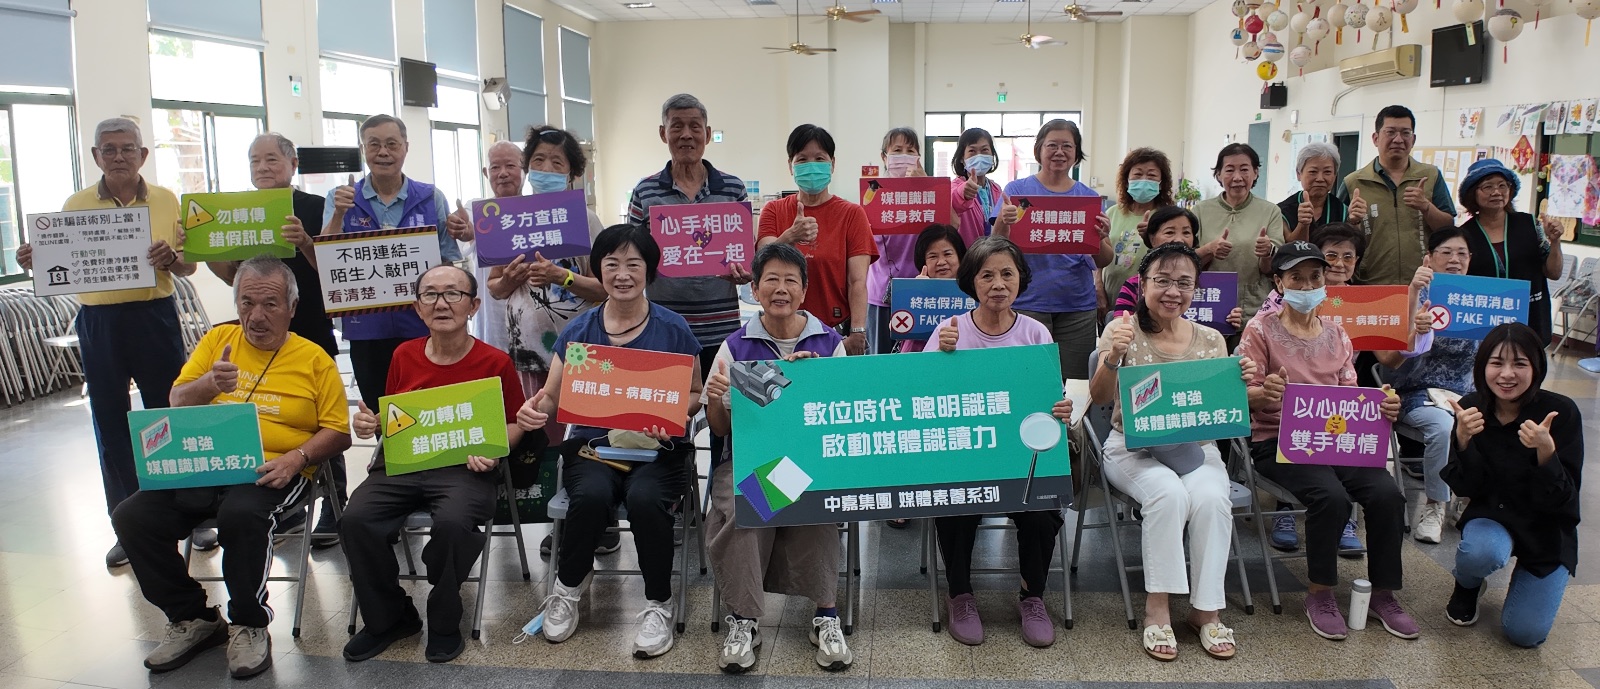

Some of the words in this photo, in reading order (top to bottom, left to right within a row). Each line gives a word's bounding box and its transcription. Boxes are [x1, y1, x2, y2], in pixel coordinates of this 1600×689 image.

[881, 190, 936, 205] 媒體識讀
[216, 207, 266, 225] 勿轉傳
[500, 208, 568, 230] 多方查證
[661, 213, 743, 235] 心手相映
[881, 209, 935, 223] 終身教育
[1030, 210, 1086, 225] 媒體識讀
[209, 229, 275, 248] 錯假訊息
[511, 229, 563, 250] 免受騙
[1030, 228, 1085, 243] 終身教育
[71, 249, 106, 258] 行動守則
[662, 243, 745, 266] 愛在一起
[83, 264, 139, 276] 官方公告優先查
[910, 296, 976, 310] 終結假消息
[920, 314, 946, 325] FAKE
[1356, 315, 1400, 326] 病毒行銷
[1456, 312, 1483, 325] FAKE
[236, 369, 268, 385] AINAN
[236, 380, 252, 390] ALF
[226, 390, 282, 403] ARATHON
[571, 380, 610, 397] 假訊息
[626, 386, 679, 405] 病毒行銷
[1171, 390, 1203, 407] 增強
[418, 402, 473, 427] 勿轉傳
[803, 397, 902, 426] 數位時代
[911, 391, 1011, 419] 聰明識讀
[1293, 396, 1381, 421] 以心映心
[1134, 408, 1243, 432] 媒體識讀免疫力
[182, 436, 214, 453] 增強
[412, 427, 485, 455] 錯假訊息
[822, 425, 997, 458] 啟動媒體識讀力
[1289, 429, 1378, 454] 雙手傳情
[146, 454, 256, 475] 媒體識讀免疫力
[824, 492, 892, 513] 中嘉集團
[898, 485, 1000, 508] 媒體素養系列
